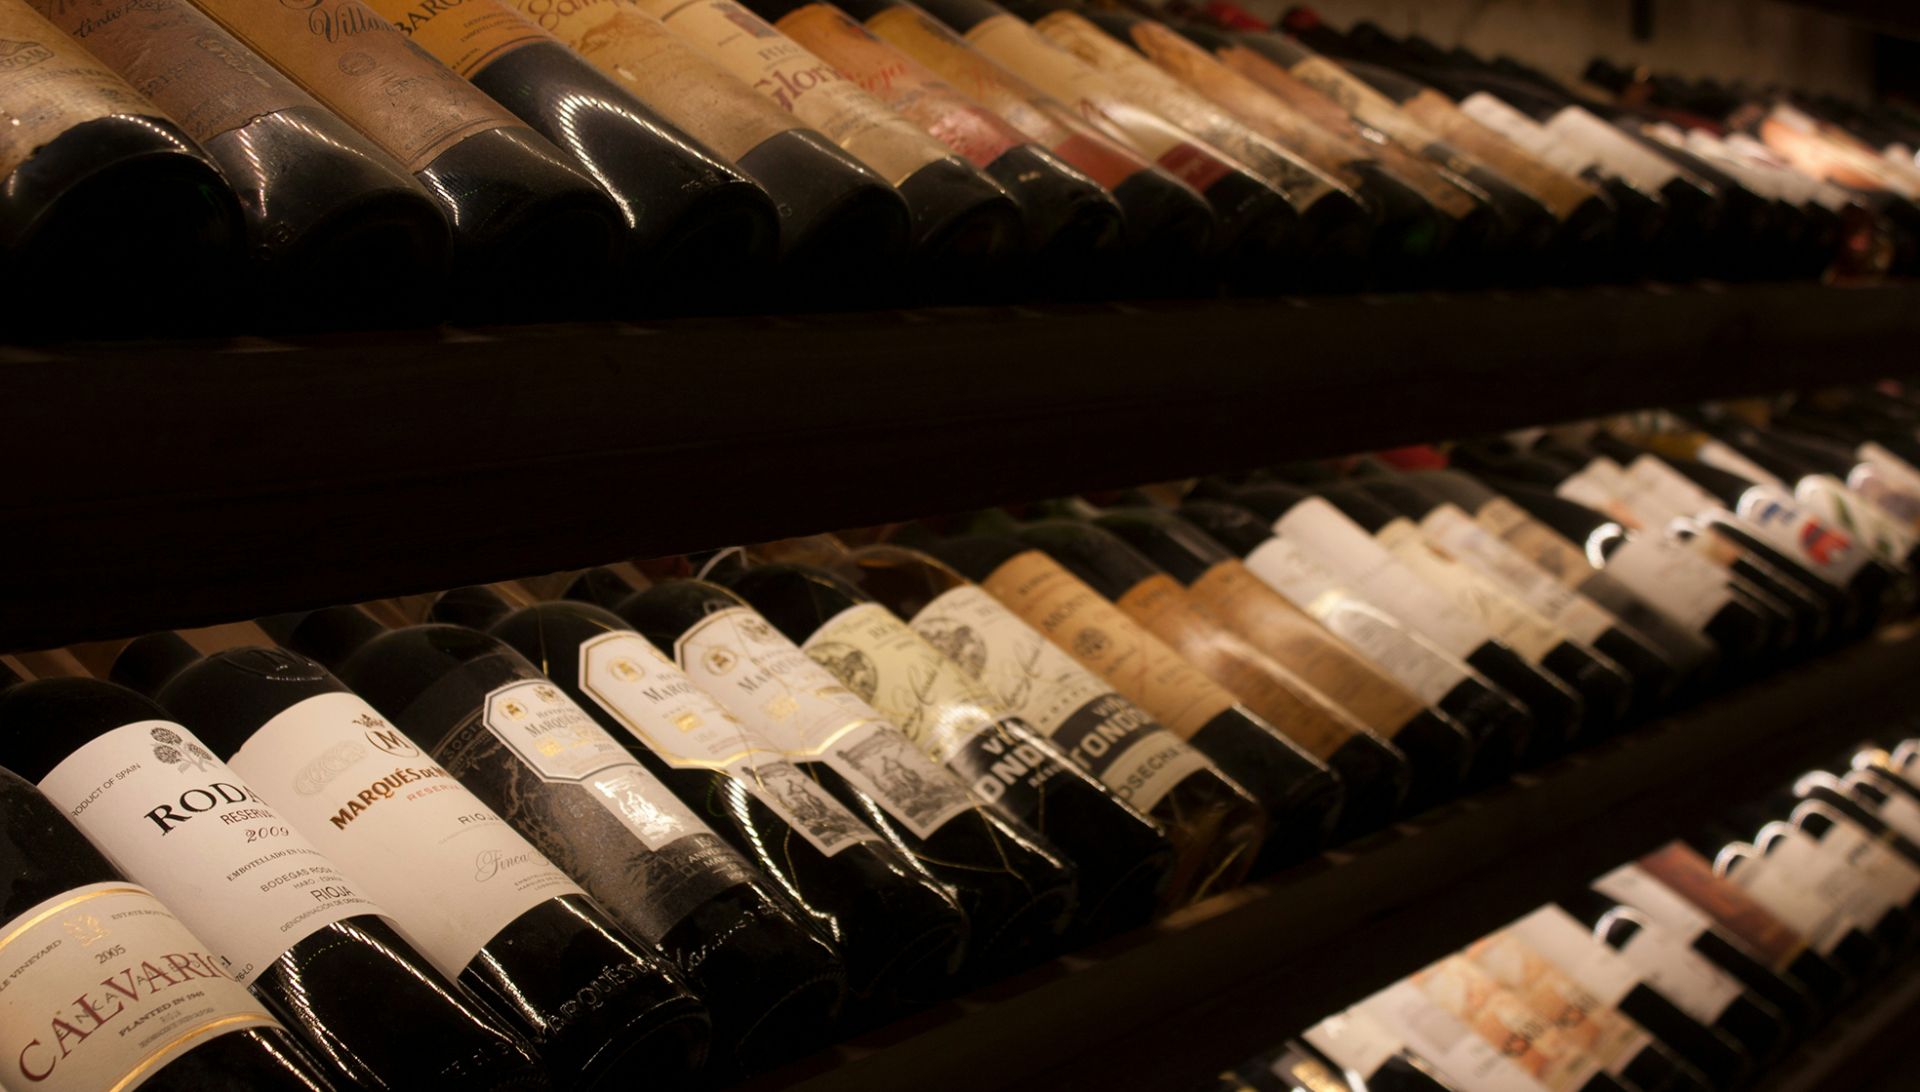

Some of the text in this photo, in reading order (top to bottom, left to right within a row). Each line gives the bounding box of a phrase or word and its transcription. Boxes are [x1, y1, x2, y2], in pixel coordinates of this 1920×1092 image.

[103, 777, 115, 789] OF
[115, 762, 141, 781] SPAIN
[143, 782, 272, 837] RODA
[330, 767, 422, 831] MARQUÉS
[220, 807, 276, 826] RESERVA
[245, 826, 289, 843] 2009
[226, 851, 287, 882] EMBOTELLADO
[475, 848, 527, 883] Finca
[260, 868, 310, 893] BODEGAS
[310, 885, 356, 903] RIOJA
[9, 940, 62, 979] VINEYARD
[95, 944, 126, 965] 2005
[118, 1002, 172, 1037] PLANTED
